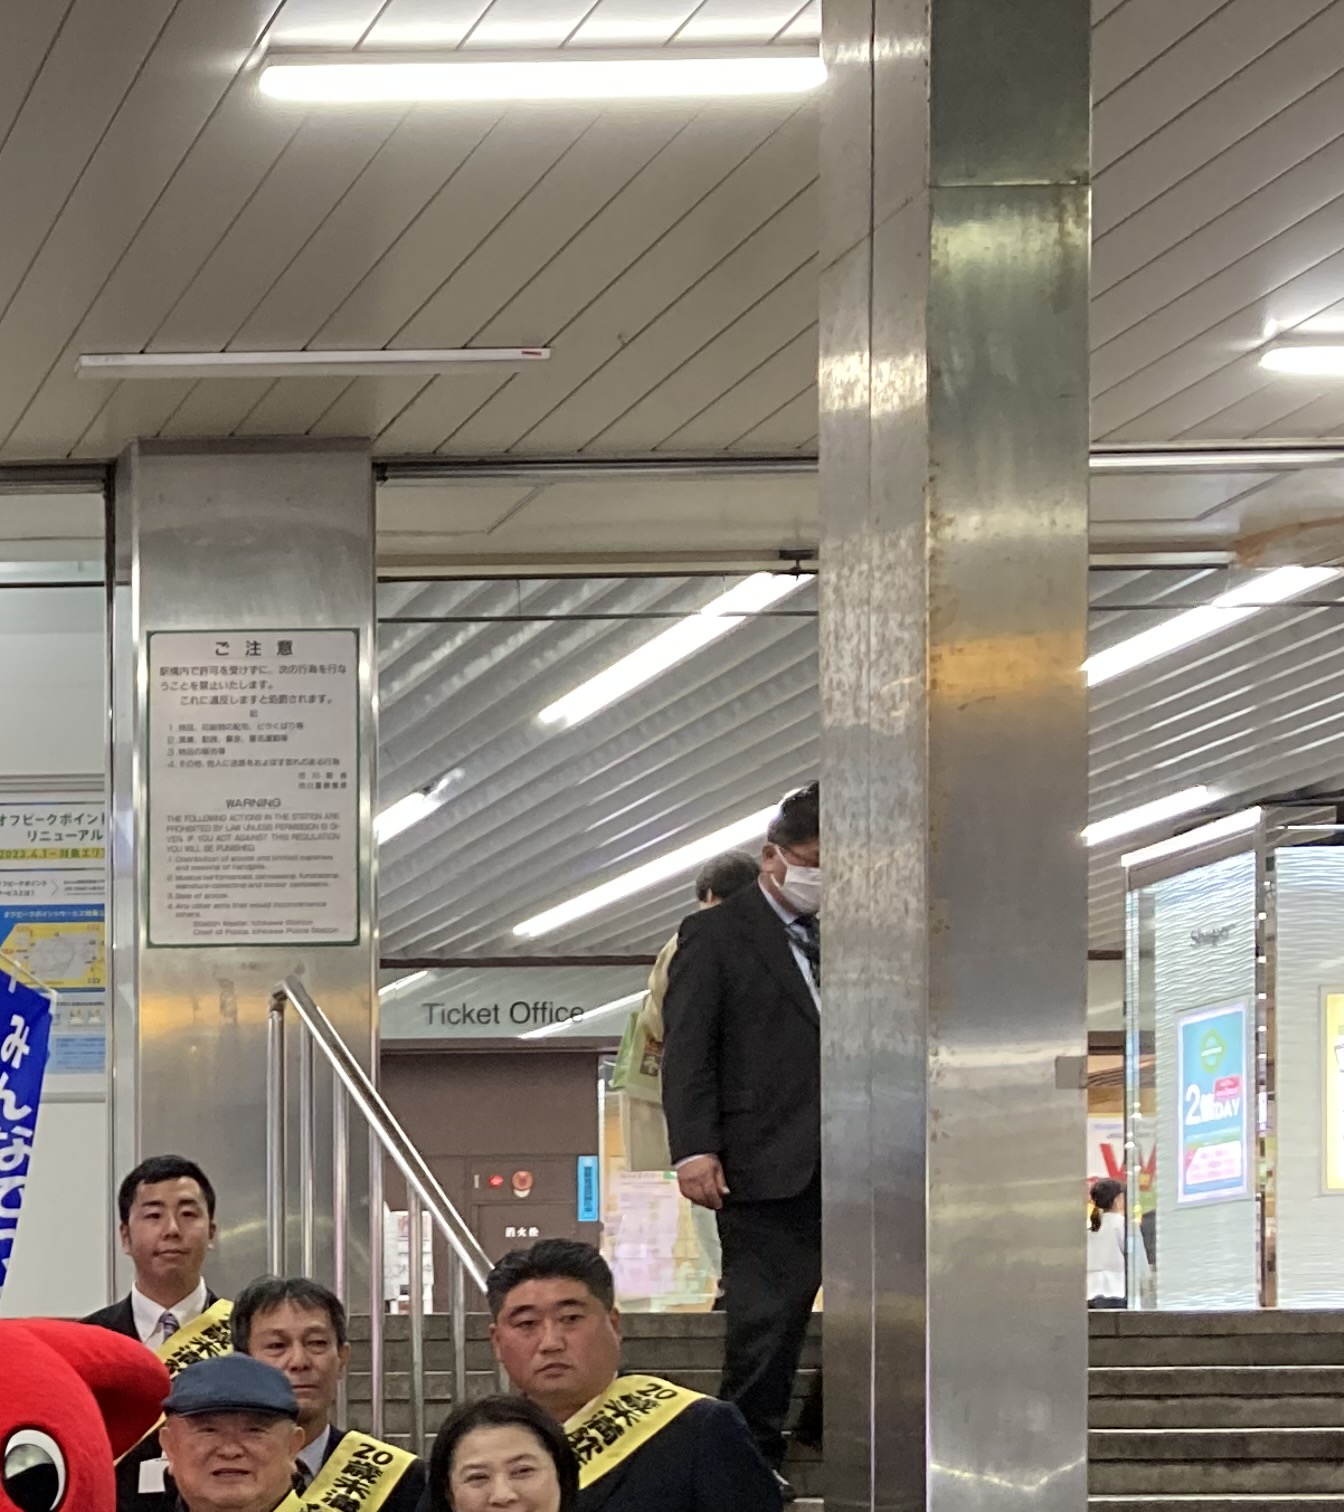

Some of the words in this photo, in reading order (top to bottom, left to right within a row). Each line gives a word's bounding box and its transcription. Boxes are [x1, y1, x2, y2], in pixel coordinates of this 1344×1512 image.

[215, 640, 293, 656] ご注意
[226, 798, 281, 808] WARNING
[27, 829, 103, 842] リニューアル
[422, 1001, 501, 1025] Ticket
[509, 1001, 585, 1025] Office
[564, 1382, 677, 1470] 20歳未満飲
